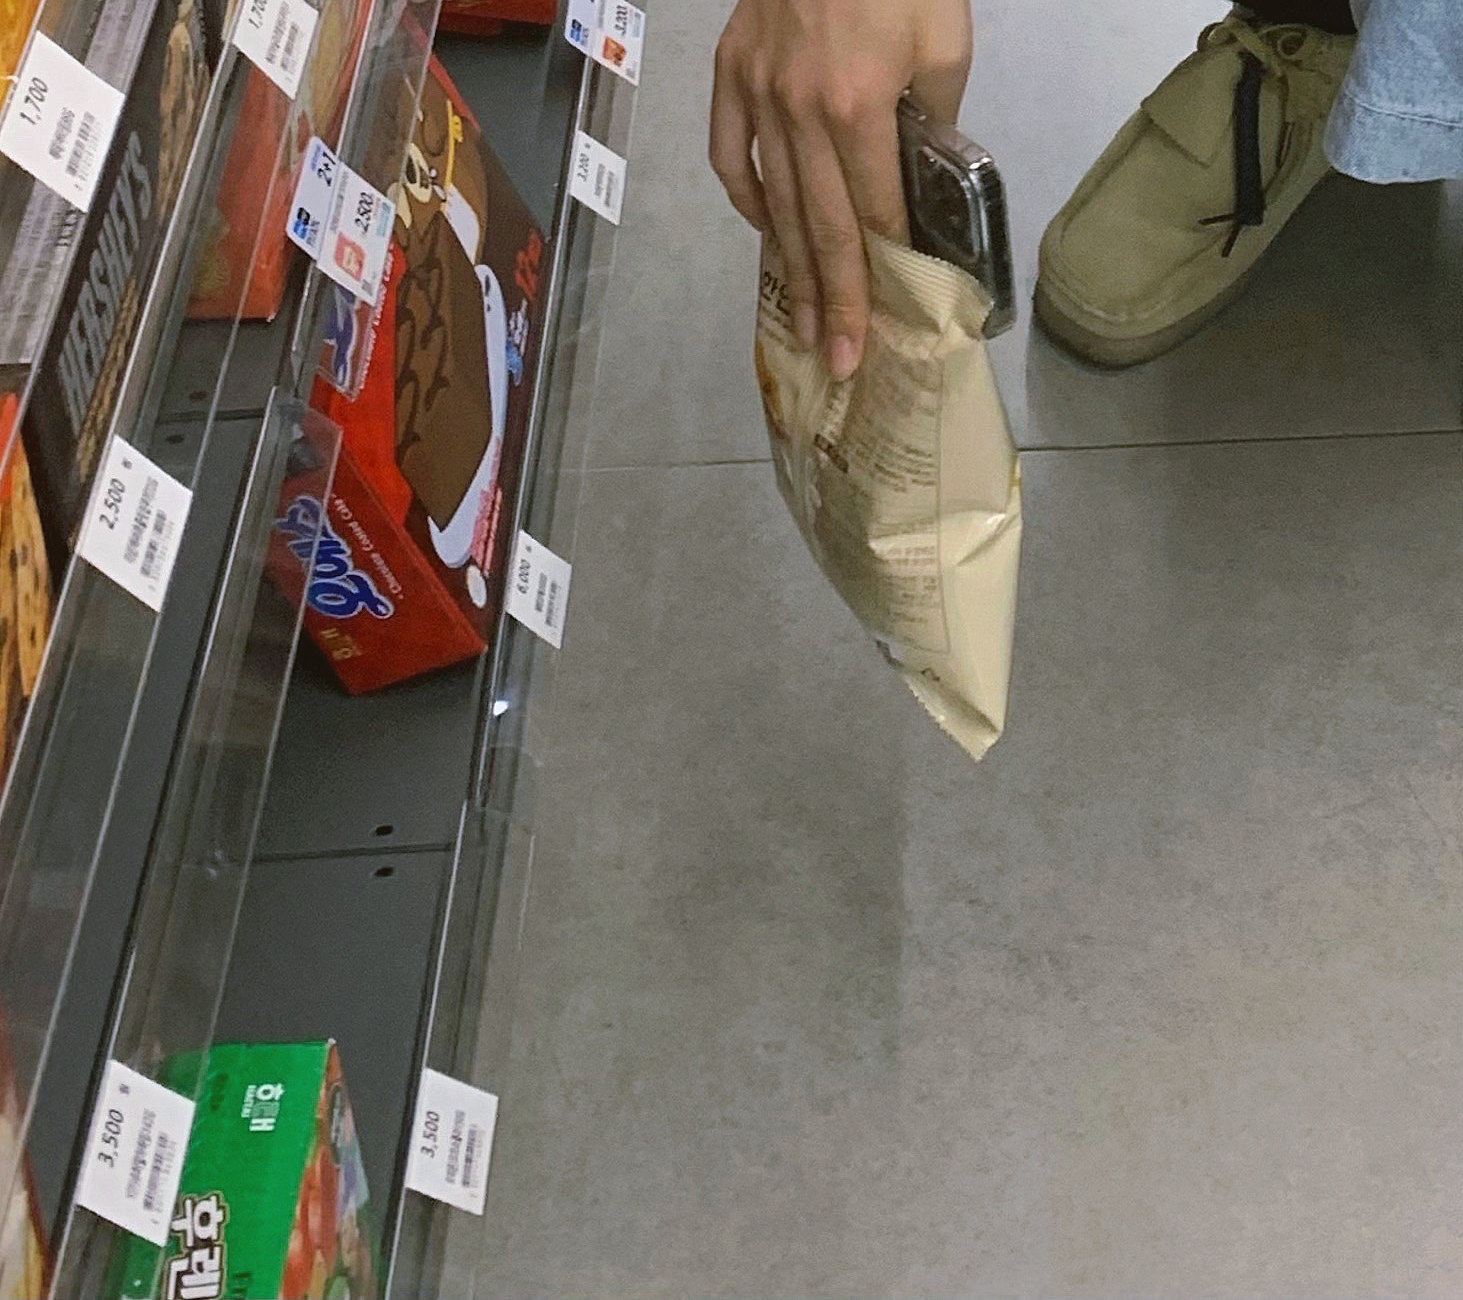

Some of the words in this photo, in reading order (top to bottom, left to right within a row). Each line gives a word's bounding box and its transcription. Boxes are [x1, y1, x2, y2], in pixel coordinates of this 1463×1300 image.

[18, 75, 51, 127] 1,700
[315, 150, 338, 187] 2+1
[576, 152, 591, 183] 3,200
[352, 190, 377, 238] 2,500
[56, 125, 153, 433] HERSHEY'S
[97, 476, 129, 531] 2,500
[516, 557, 533, 596] 6,000
[97, 1107, 126, 1169] 3,500
[421, 1109, 441, 1159] 3,500
